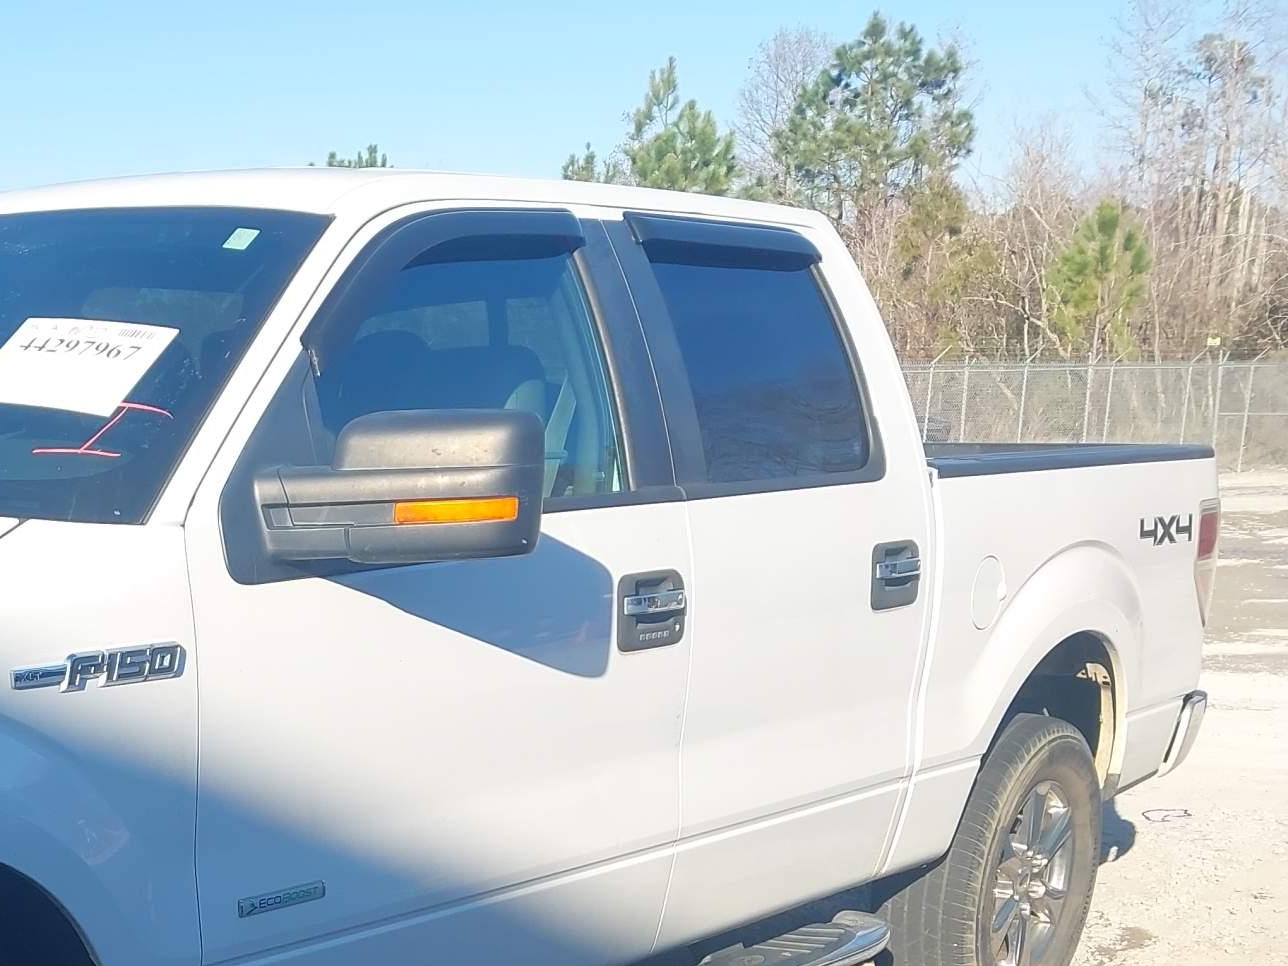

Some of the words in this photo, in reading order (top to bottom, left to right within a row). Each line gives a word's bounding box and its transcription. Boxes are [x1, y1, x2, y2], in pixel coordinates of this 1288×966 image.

[19, 336, 143, 361] 44297967
[1139, 512, 1193, 547] 4X4
[59, 641, 187, 694] F150
